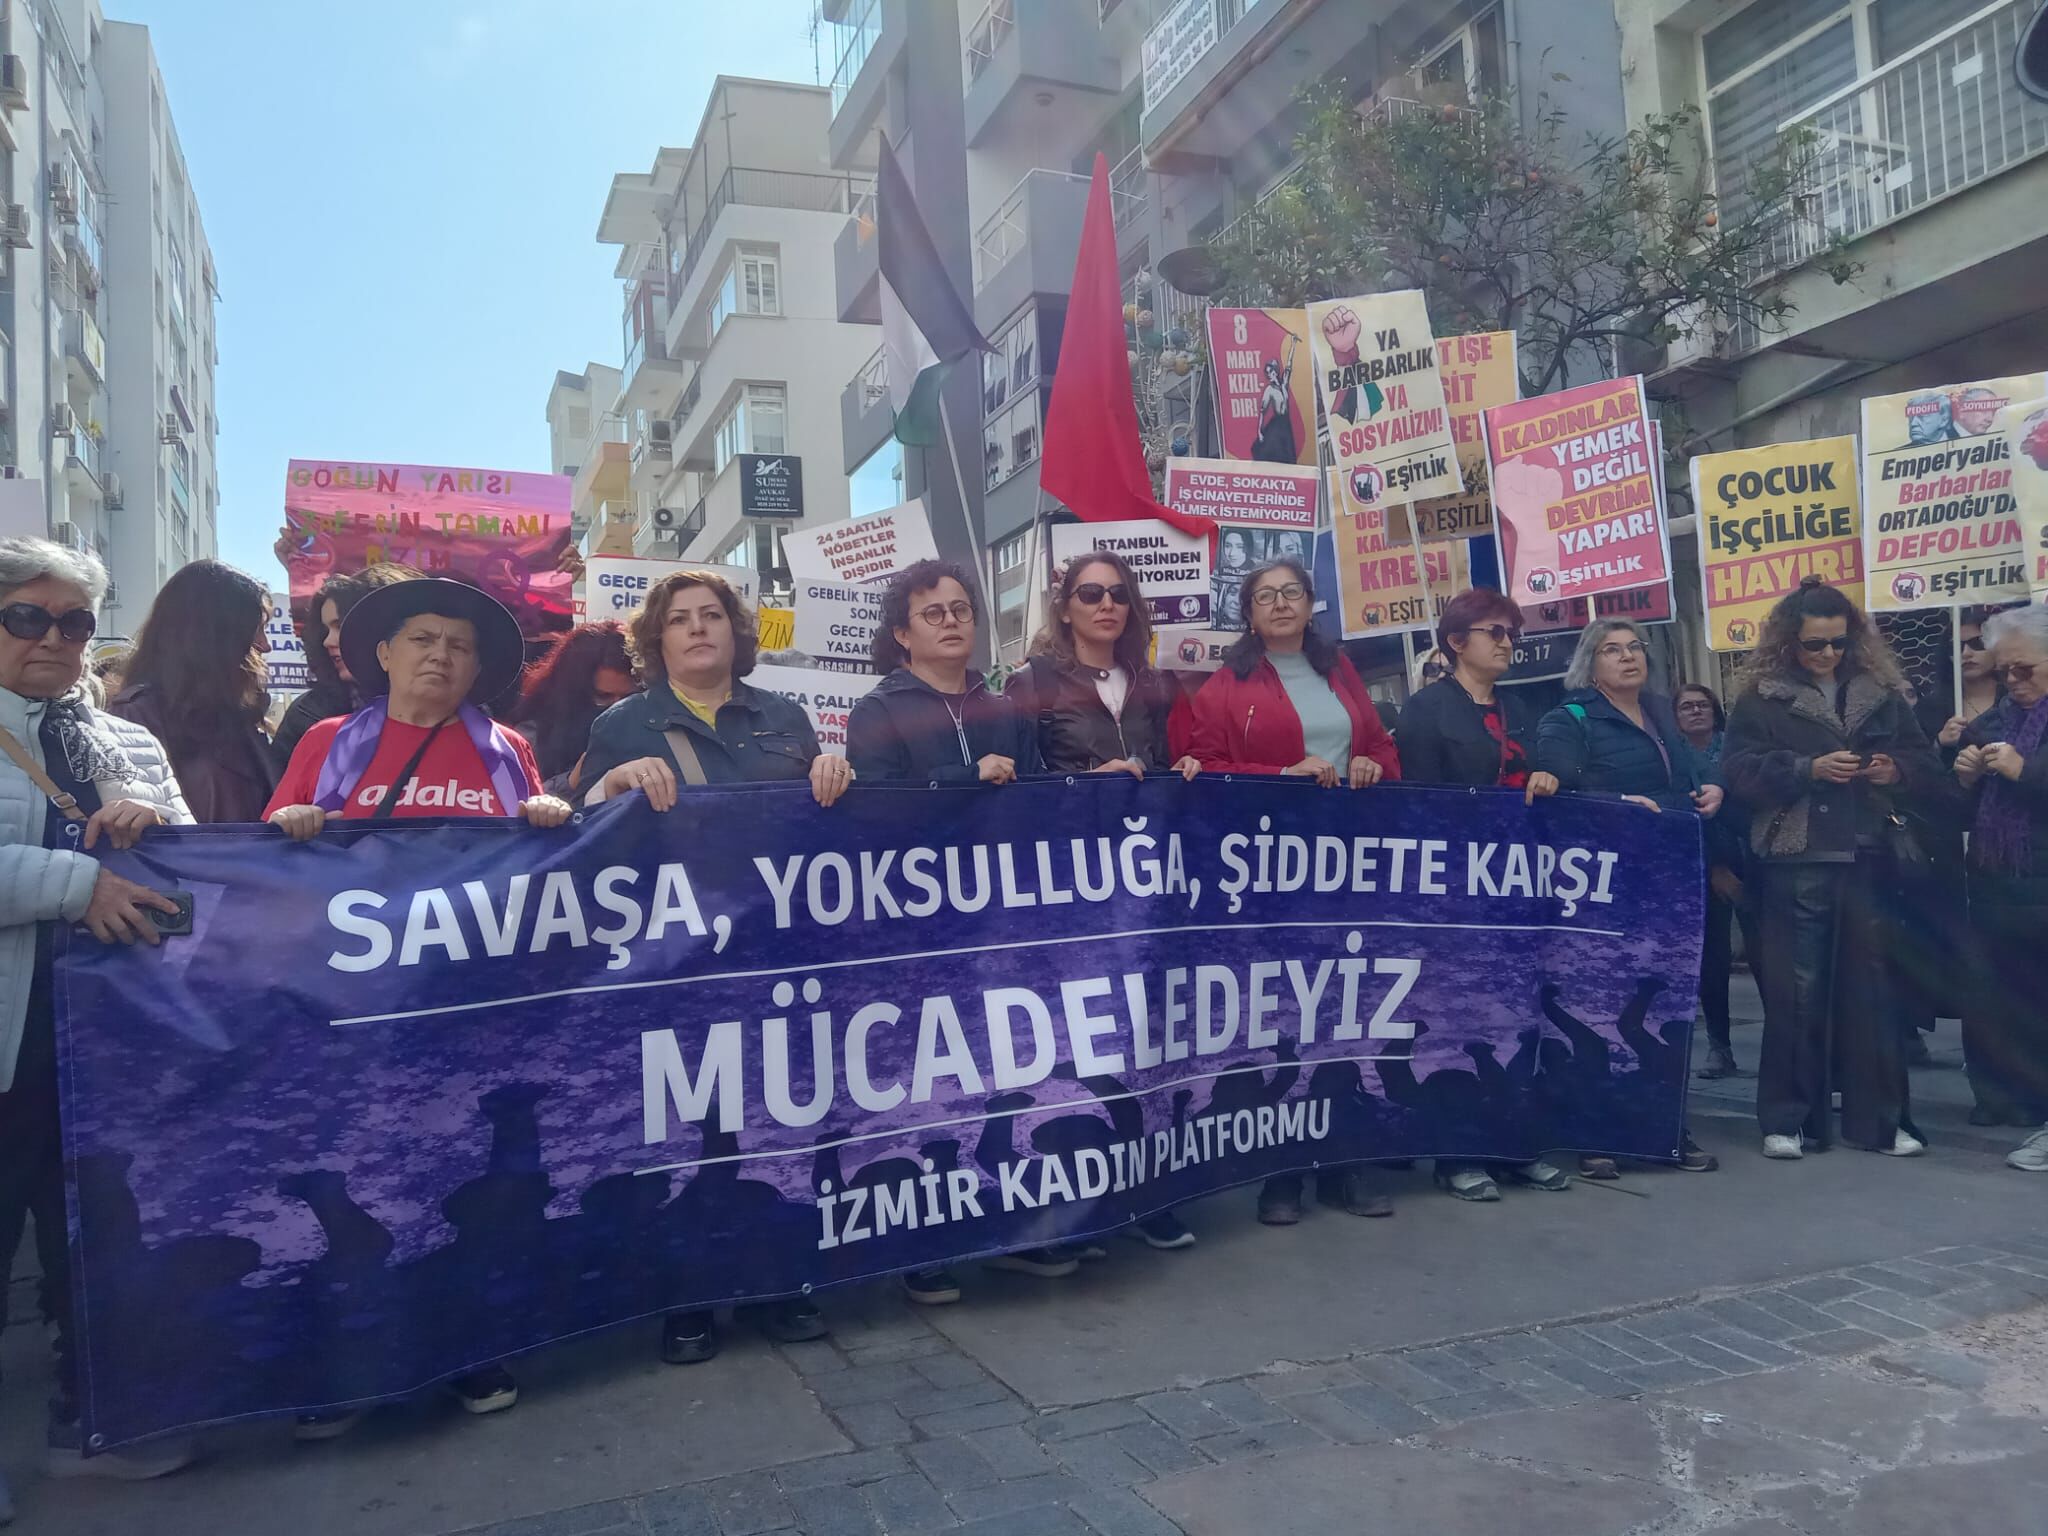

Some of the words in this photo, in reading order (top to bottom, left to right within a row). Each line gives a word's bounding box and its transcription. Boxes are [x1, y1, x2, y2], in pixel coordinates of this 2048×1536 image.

[1234, 314, 1248, 345] 8
[1375, 328, 1400, 352] YA
[1226, 350, 1261, 369] MART
[1328, 346, 1434, 393] BARBARLIK
[1228, 373, 1264, 394] KIZIL-
[1385, 384, 1408, 411] YA
[1231, 398, 1259, 418] DIR!
[1503, 392, 1638, 454] KADINLAR
[1339, 407, 1444, 458] SOSYALİZM!
[1551, 420, 1642, 467] YEMEK
[1190, 474, 1229, 489] EVDE,
[1232, 477, 1296, 492] SOKAKTA
[1385, 454, 1448, 492] EŞİTLİK
[1573, 450, 1646, 492] DEĞİL
[1718, 461, 1836, 509] ÇOCUK
[1171, 501, 1218, 516] ÖLMEK
[1219, 504, 1311, 522] İSTEMİYORUZ!
[1179, 486, 1192, 502] İŞ
[1193, 489, 1305, 507] CİNAYETLERİNDE
[1547, 479, 1651, 530] DEVRİM
[435, 513, 549, 537] TAMAMI
[816, 532, 833, 545] 24
[836, 516, 895, 539] SAATLİK
[1559, 510, 1654, 555] YAPAR!
[1709, 503, 1852, 555] İŞÇİLİĞE
[822, 530, 896, 557] NÖBETLER
[830, 543, 897, 569] İNSANLIK
[1093, 536, 1168, 550] İSTANBUL
[1877, 519, 2022, 563] DEFOLUN
[598, 574, 648, 590] GECE
[842, 558, 894, 580] DIŞIDIR
[1559, 555, 1643, 586] EŞİTLİK
[1713, 544, 1857, 602] HAYIR!
[1930, 560, 2026, 597] EŞİTLİK
[611, 591, 645, 610] ÇİF
[808, 586, 860, 603] GEBELİK
[1389, 593, 1452, 624] EŞİTİK
[830, 624, 865, 639] GECE
[280, 666, 309, 677] MART
[358, 776, 493, 814] adalet
[326, 862, 732, 972] SAVAŞA,
[753, 815, 1201, 930] YOKSULLUĞA,
[1218, 815, 1447, 914] ŞİDDETE
[1467, 840, 1618, 917] KARŞI
[641, 930, 1422, 1144] MÜCADELEDEYİZ
[816, 1157, 985, 1250] İZMİR
[998, 1136, 1146, 1212] KADIN
[1154, 1098, 1331, 1178] PLATFORMU
